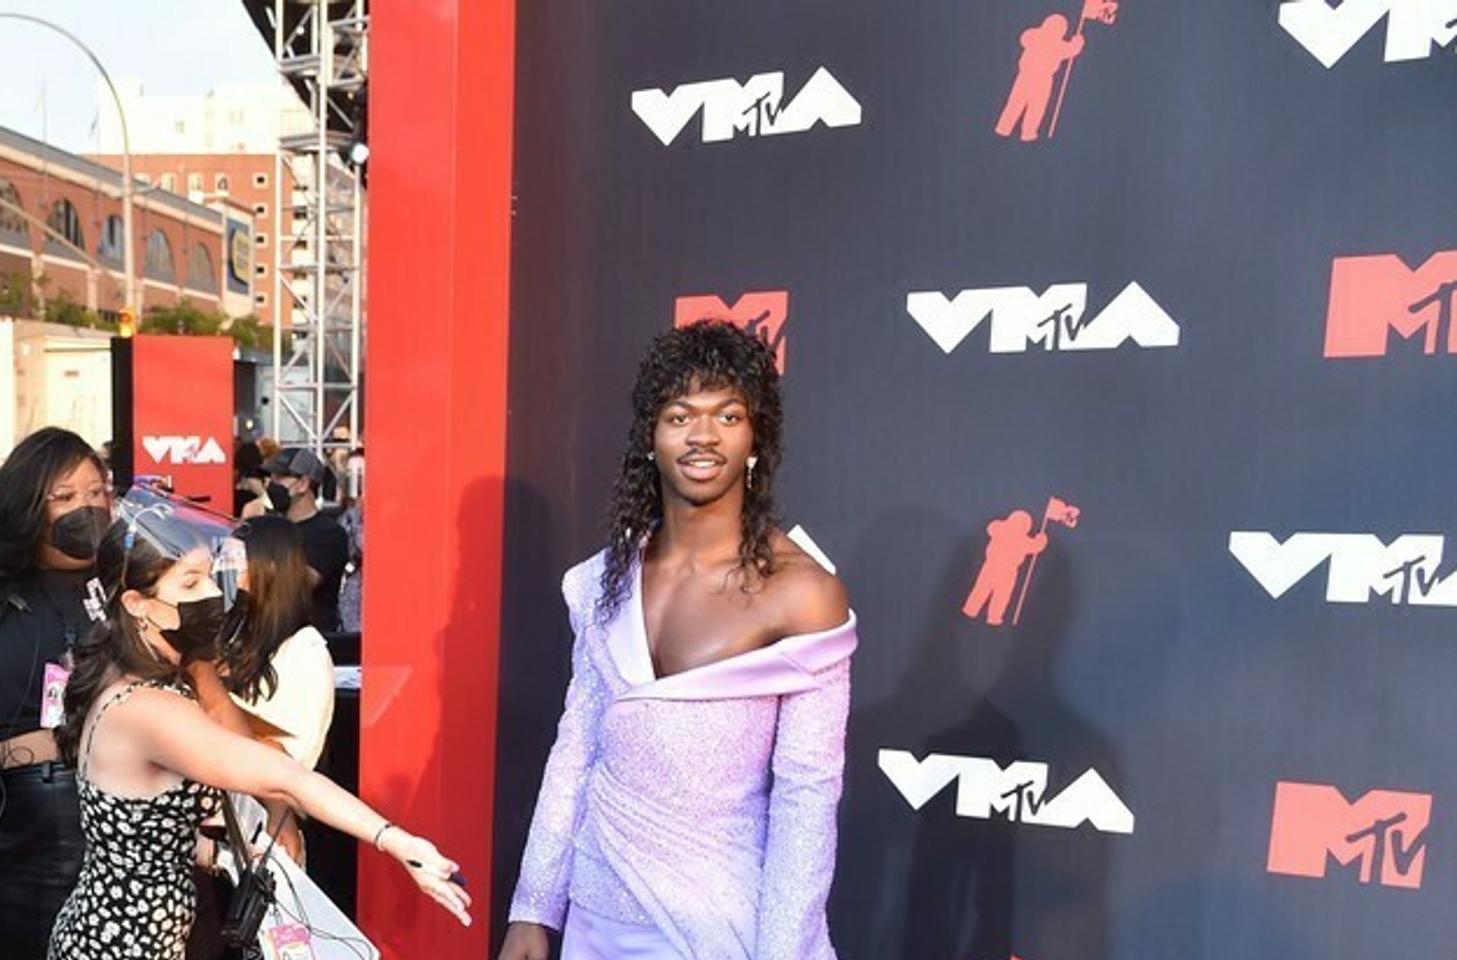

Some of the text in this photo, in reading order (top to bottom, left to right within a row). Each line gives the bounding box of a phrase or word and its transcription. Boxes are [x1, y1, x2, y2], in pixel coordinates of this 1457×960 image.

[631, 65, 862, 147] VMA
[906, 280, 1181, 354] VMA
[878, 748, 1135, 834] VMA
[1267, 781, 1433, 890] MTV
